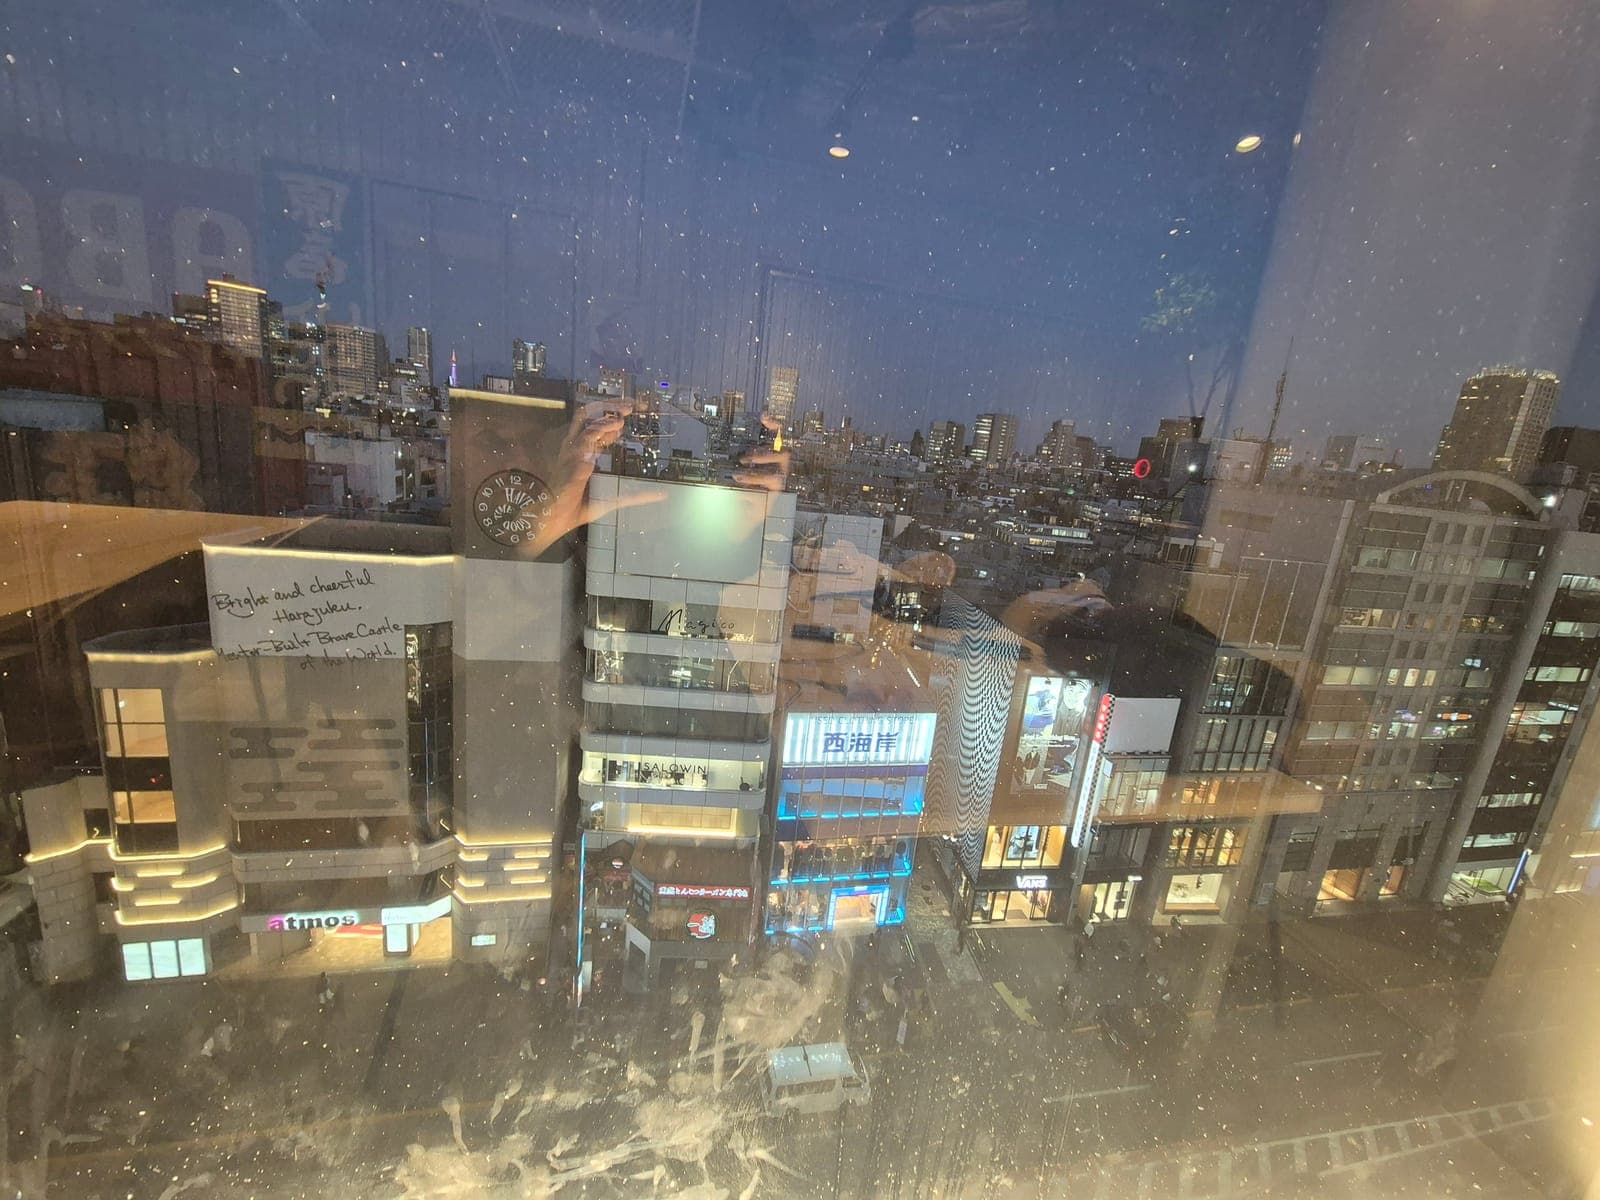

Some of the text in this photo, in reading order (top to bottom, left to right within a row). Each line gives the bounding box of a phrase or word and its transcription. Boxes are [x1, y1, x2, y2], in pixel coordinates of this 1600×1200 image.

[211, 568, 376, 618] Bright and cheerful
[306, 631, 357, 645] Brave
[356, 616, 402, 638] Castle
[823, 731, 900, 753] 西海岸
[643, 761, 707, 775] SALOWIN
[1016, 875, 1048, 889] VANS
[267, 914, 356, 932] atmos
